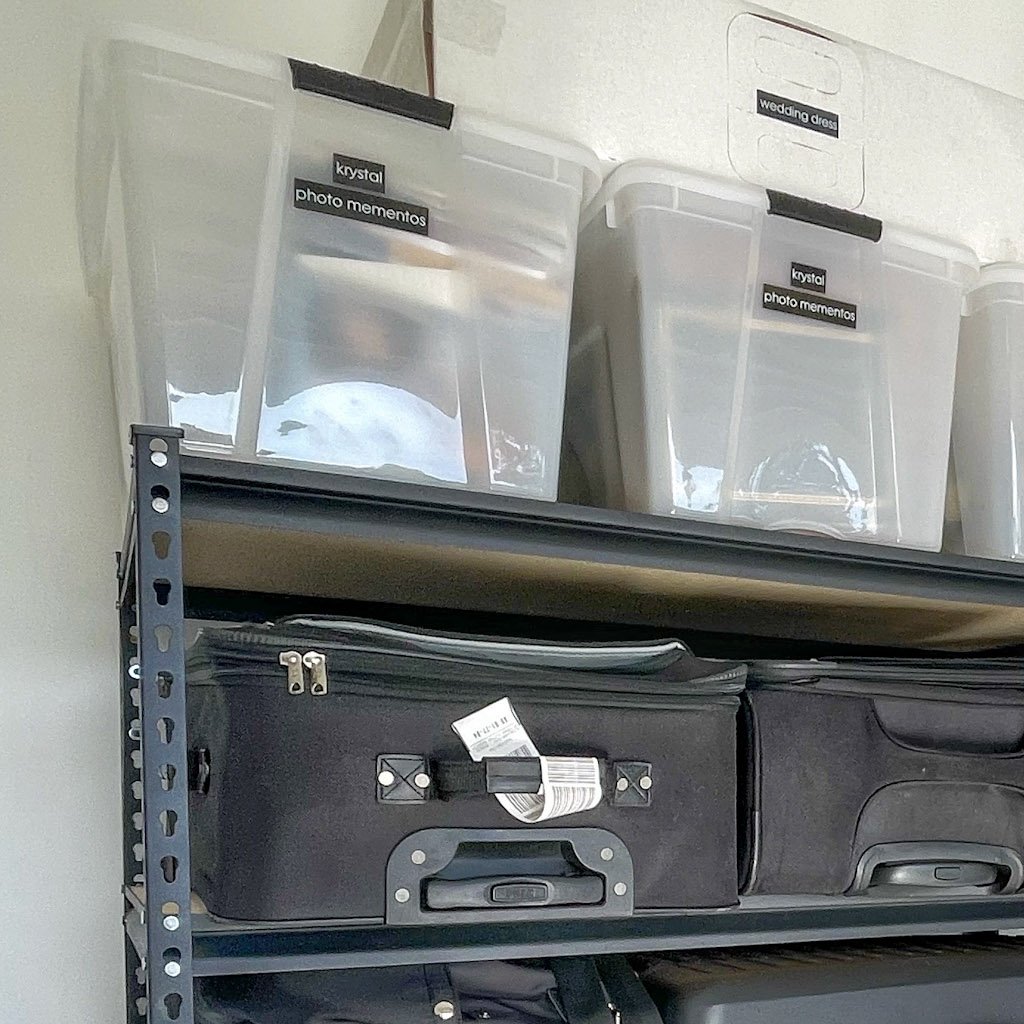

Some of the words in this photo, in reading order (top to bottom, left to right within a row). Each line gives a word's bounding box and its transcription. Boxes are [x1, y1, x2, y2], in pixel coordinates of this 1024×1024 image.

[759, 98, 809, 123] wedding
[811, 113, 838, 131] dress
[335, 160, 383, 184] krystal
[295, 187, 343, 209] photo
[346, 199, 426, 228] mementos
[791, 268, 825, 286] krystal
[763, 291, 798, 308] photo
[799, 300, 855, 322] mementos
